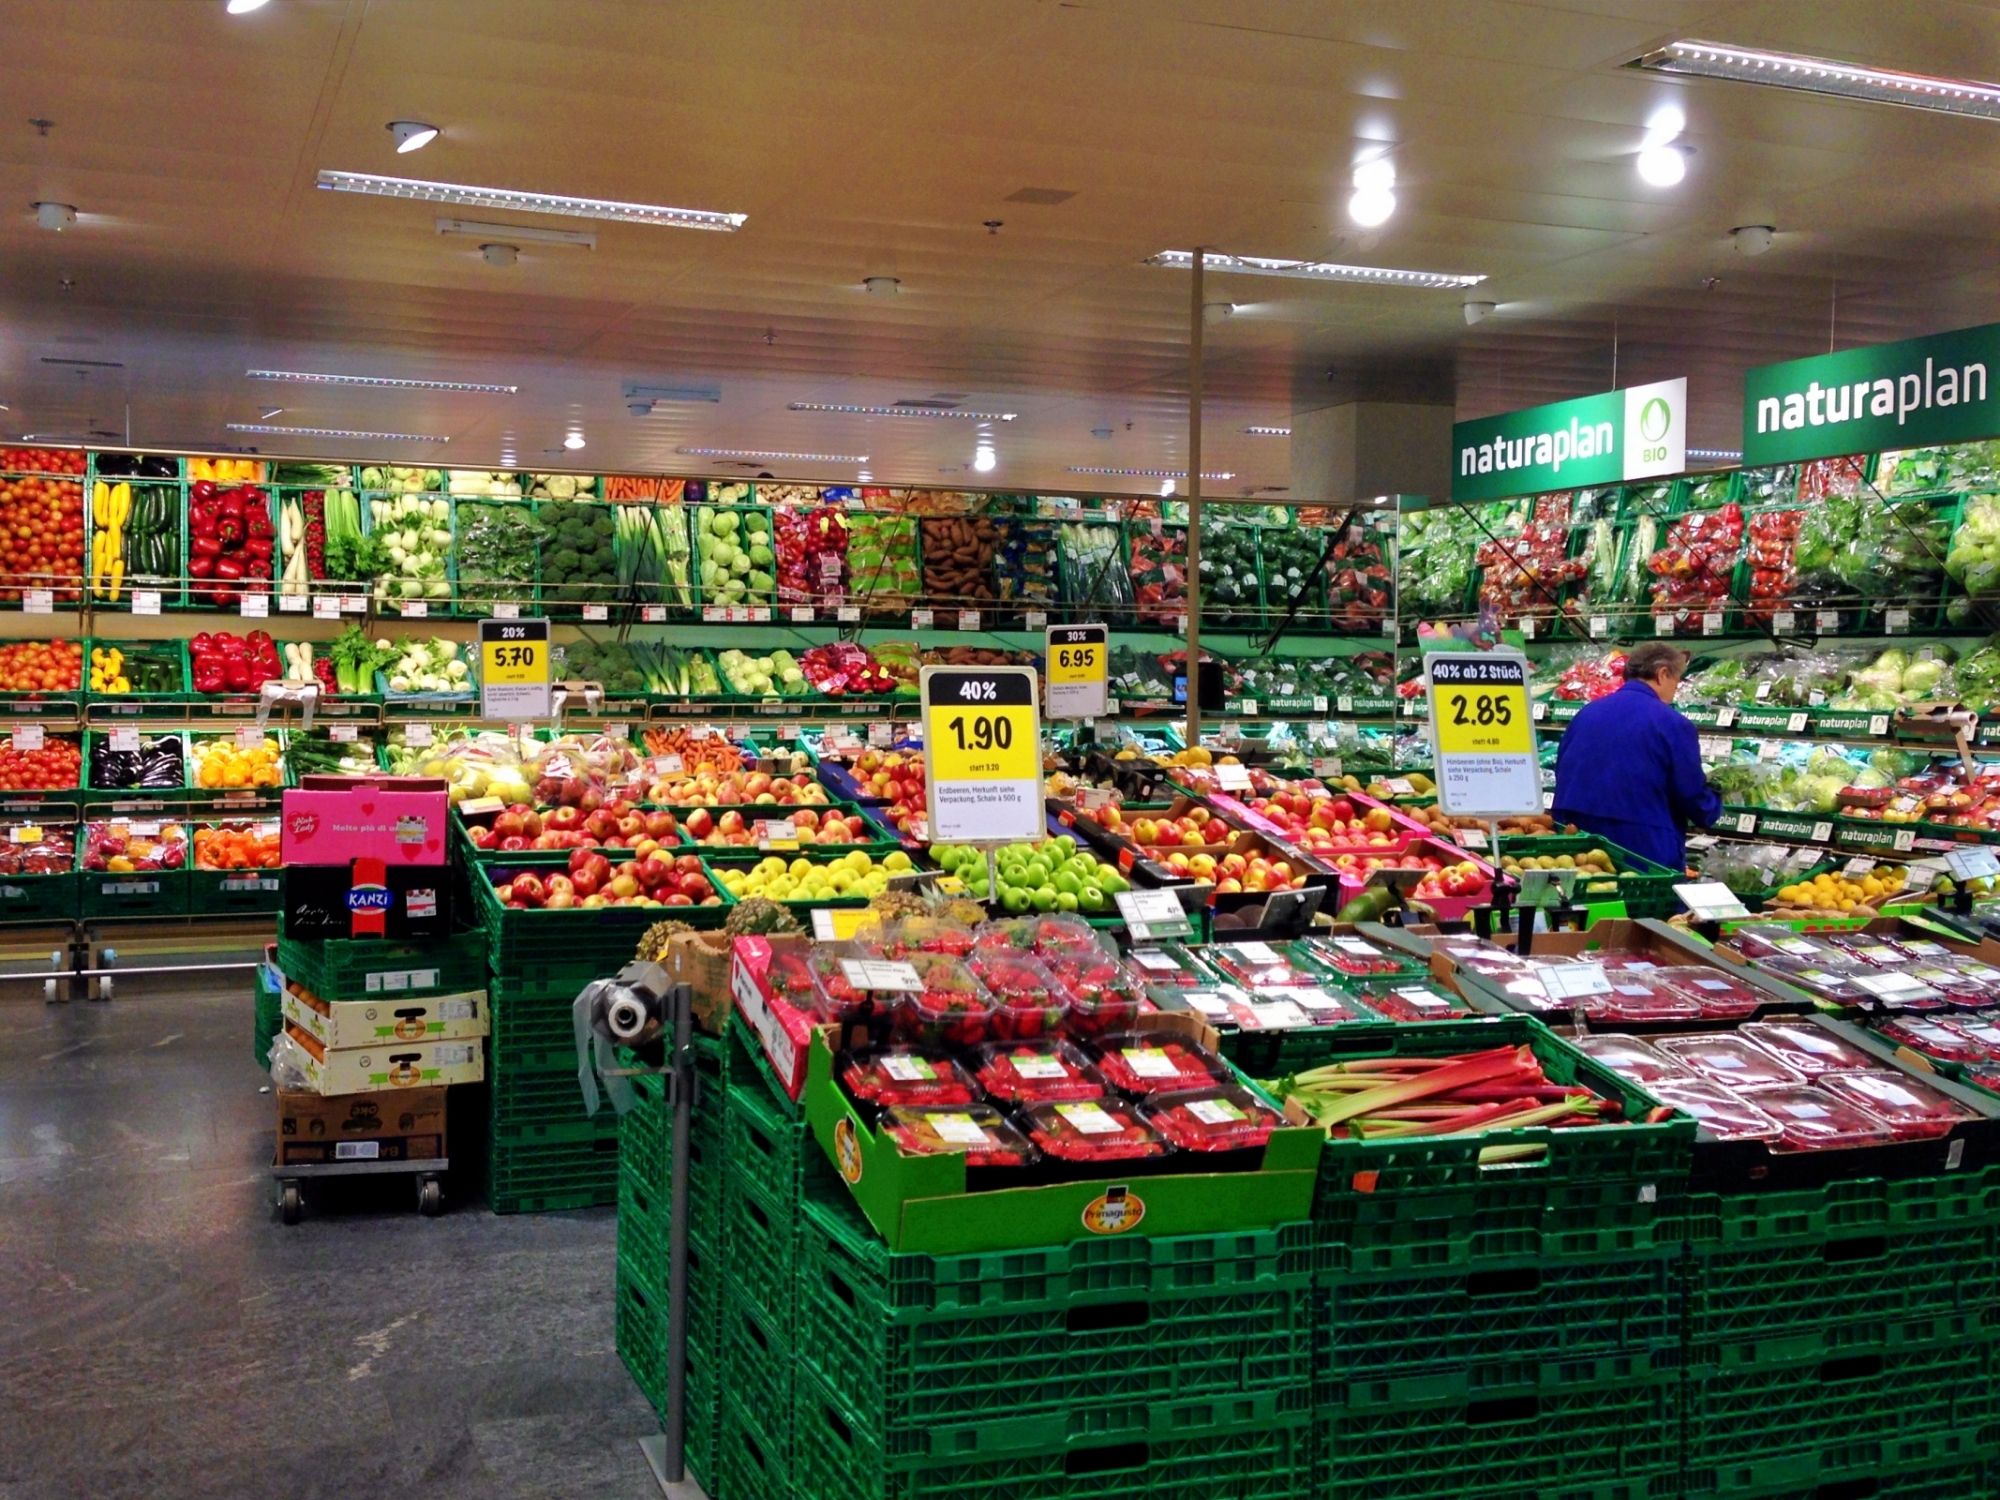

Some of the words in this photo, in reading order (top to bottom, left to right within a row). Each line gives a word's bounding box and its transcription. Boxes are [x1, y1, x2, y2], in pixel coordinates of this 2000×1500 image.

[1758, 357, 1987, 434] naturaplan
[1461, 416, 1614, 476] naturaplan
[1643, 446, 1667, 463] BIO
[501, 627, 525, 638] 20%
[1067, 631, 1086, 641] 30%
[495, 647, 534, 667] 5.70
[1060, 649, 1094, 668] 6.95
[1433, 664, 1460, 678] 40%
[1463, 665, 1478, 679] ab
[1479, 665, 1487, 679] 2
[1489, 665, 1522, 679] Stück
[960, 681, 997, 700] 40%
[1270, 698, 1312, 709] naturaplan
[1451, 694, 1511, 726] 2.85
[1741, 713, 1787, 727] naturaplan
[1820, 717, 1868, 730] naturaplan
[949, 716, 1012, 750] 1.90
[939, 786, 971, 795] Erdbeeren,
[972, 785, 998, 793] Herkunft
[977, 794, 996, 802] Schale
[1003, 794, 1016, 802] 500
[1763, 819, 1812, 834] naturaplan
[1841, 830, 1893, 845] naturaplan
[1084, 1207, 1143, 1220] Primagusto
